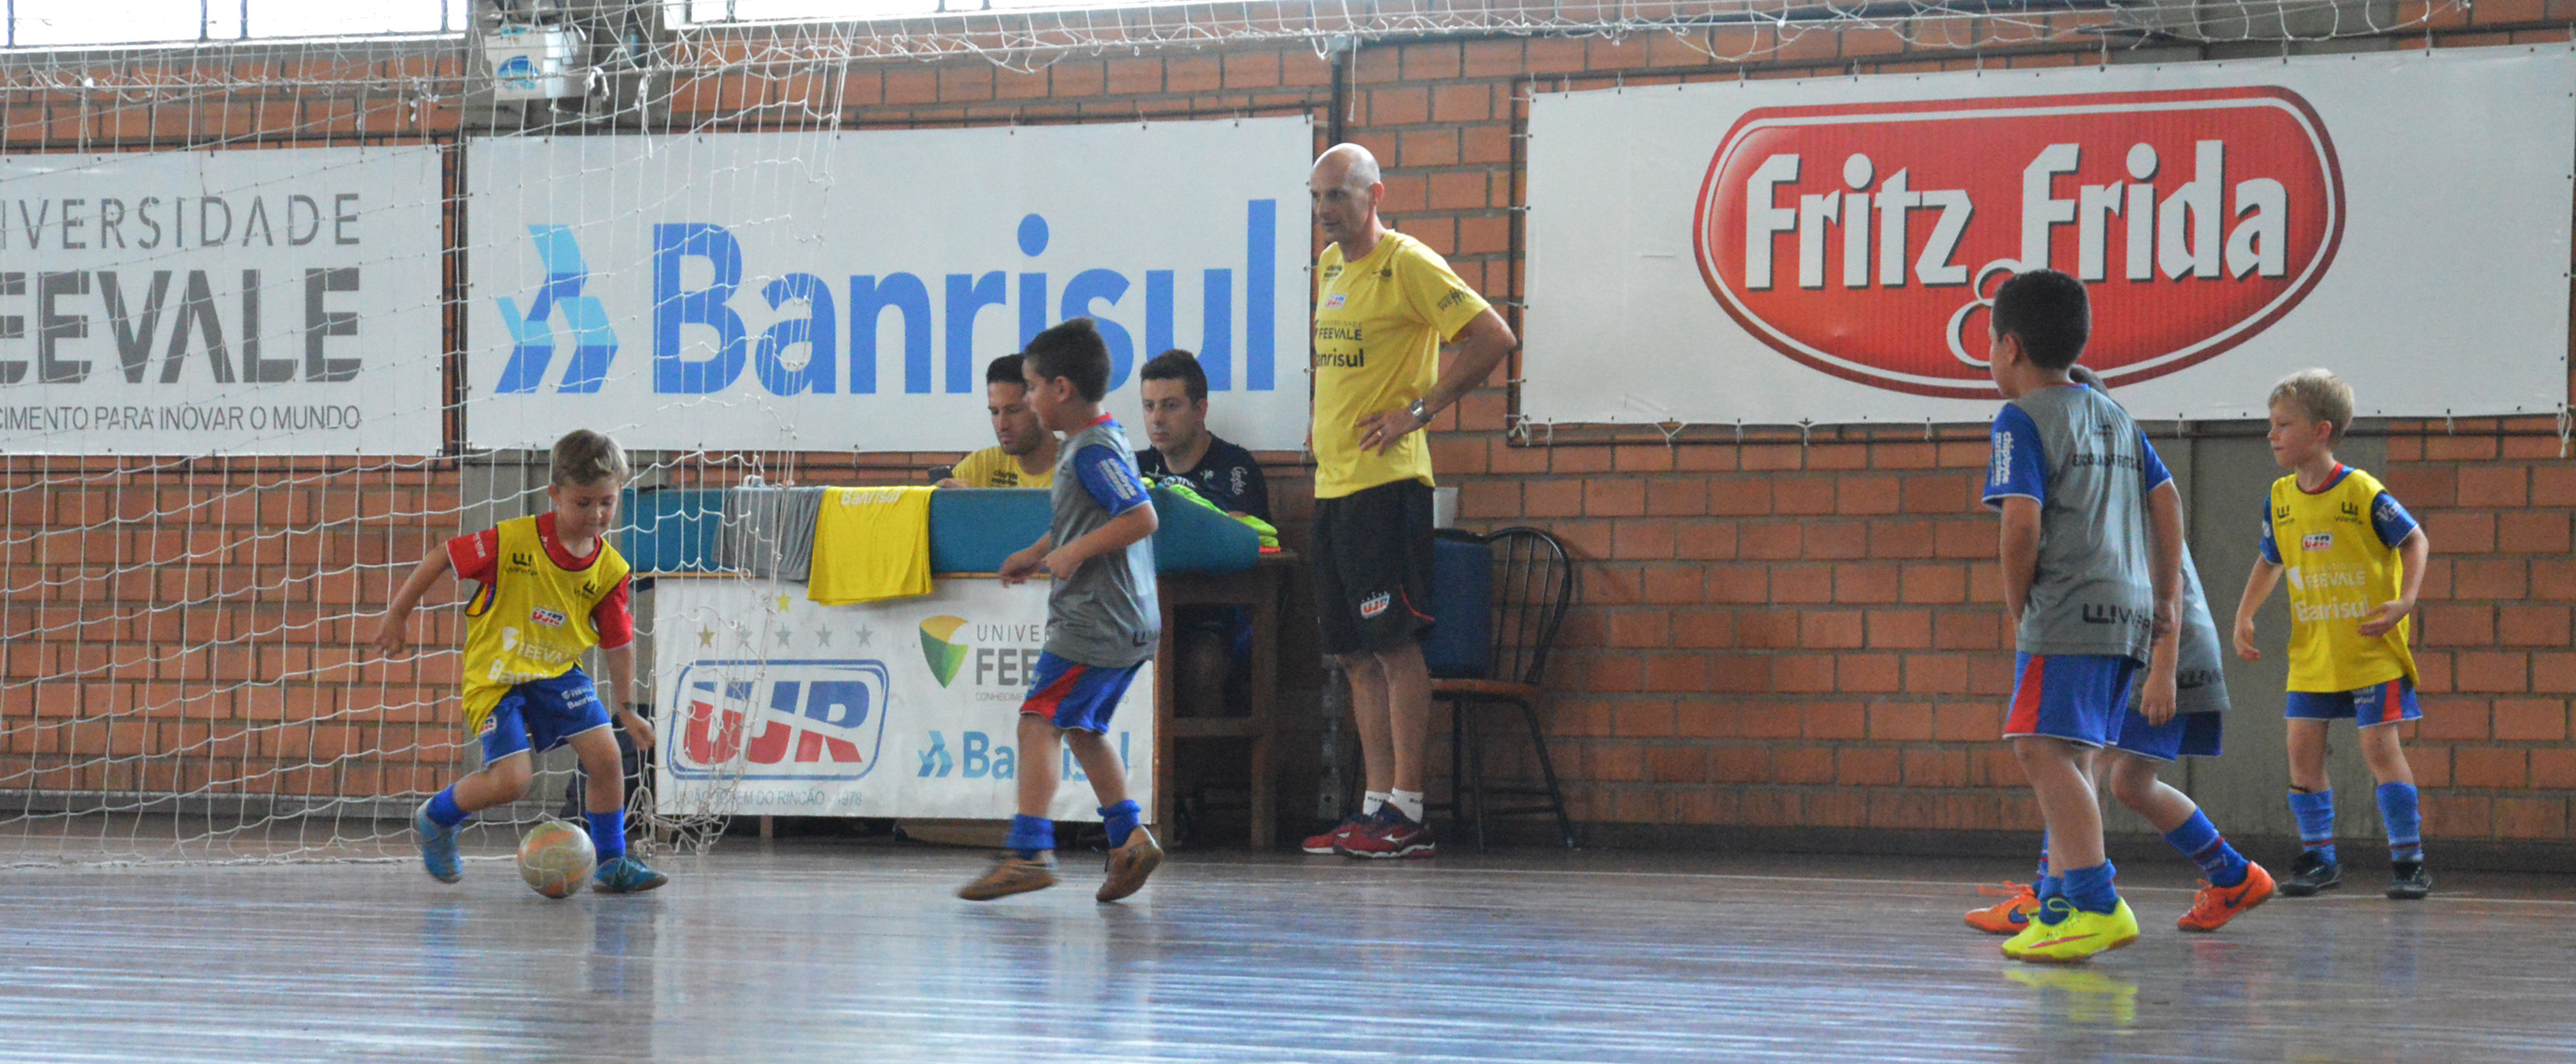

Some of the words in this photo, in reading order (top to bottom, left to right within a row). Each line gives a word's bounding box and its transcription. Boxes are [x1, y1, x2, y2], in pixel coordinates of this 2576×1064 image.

[1745, 153, 1975, 290] Fritz
[2021, 139, 2289, 283] Frida
[653, 199, 1276, 395] Banrisul
[1319, 327, 1363, 341] FEEVALE
[0, 406, 89, 431] IMENTO
[95, 406, 153, 430] PARA
[161, 406, 243, 430] INOVAR
[250, 406, 267, 431] O
[273, 405, 361, 430] MUNDO
[840, 486, 904, 506] Banrisul
[683, 680, 863, 765] UJR
[757, 789, 774, 806] DO
